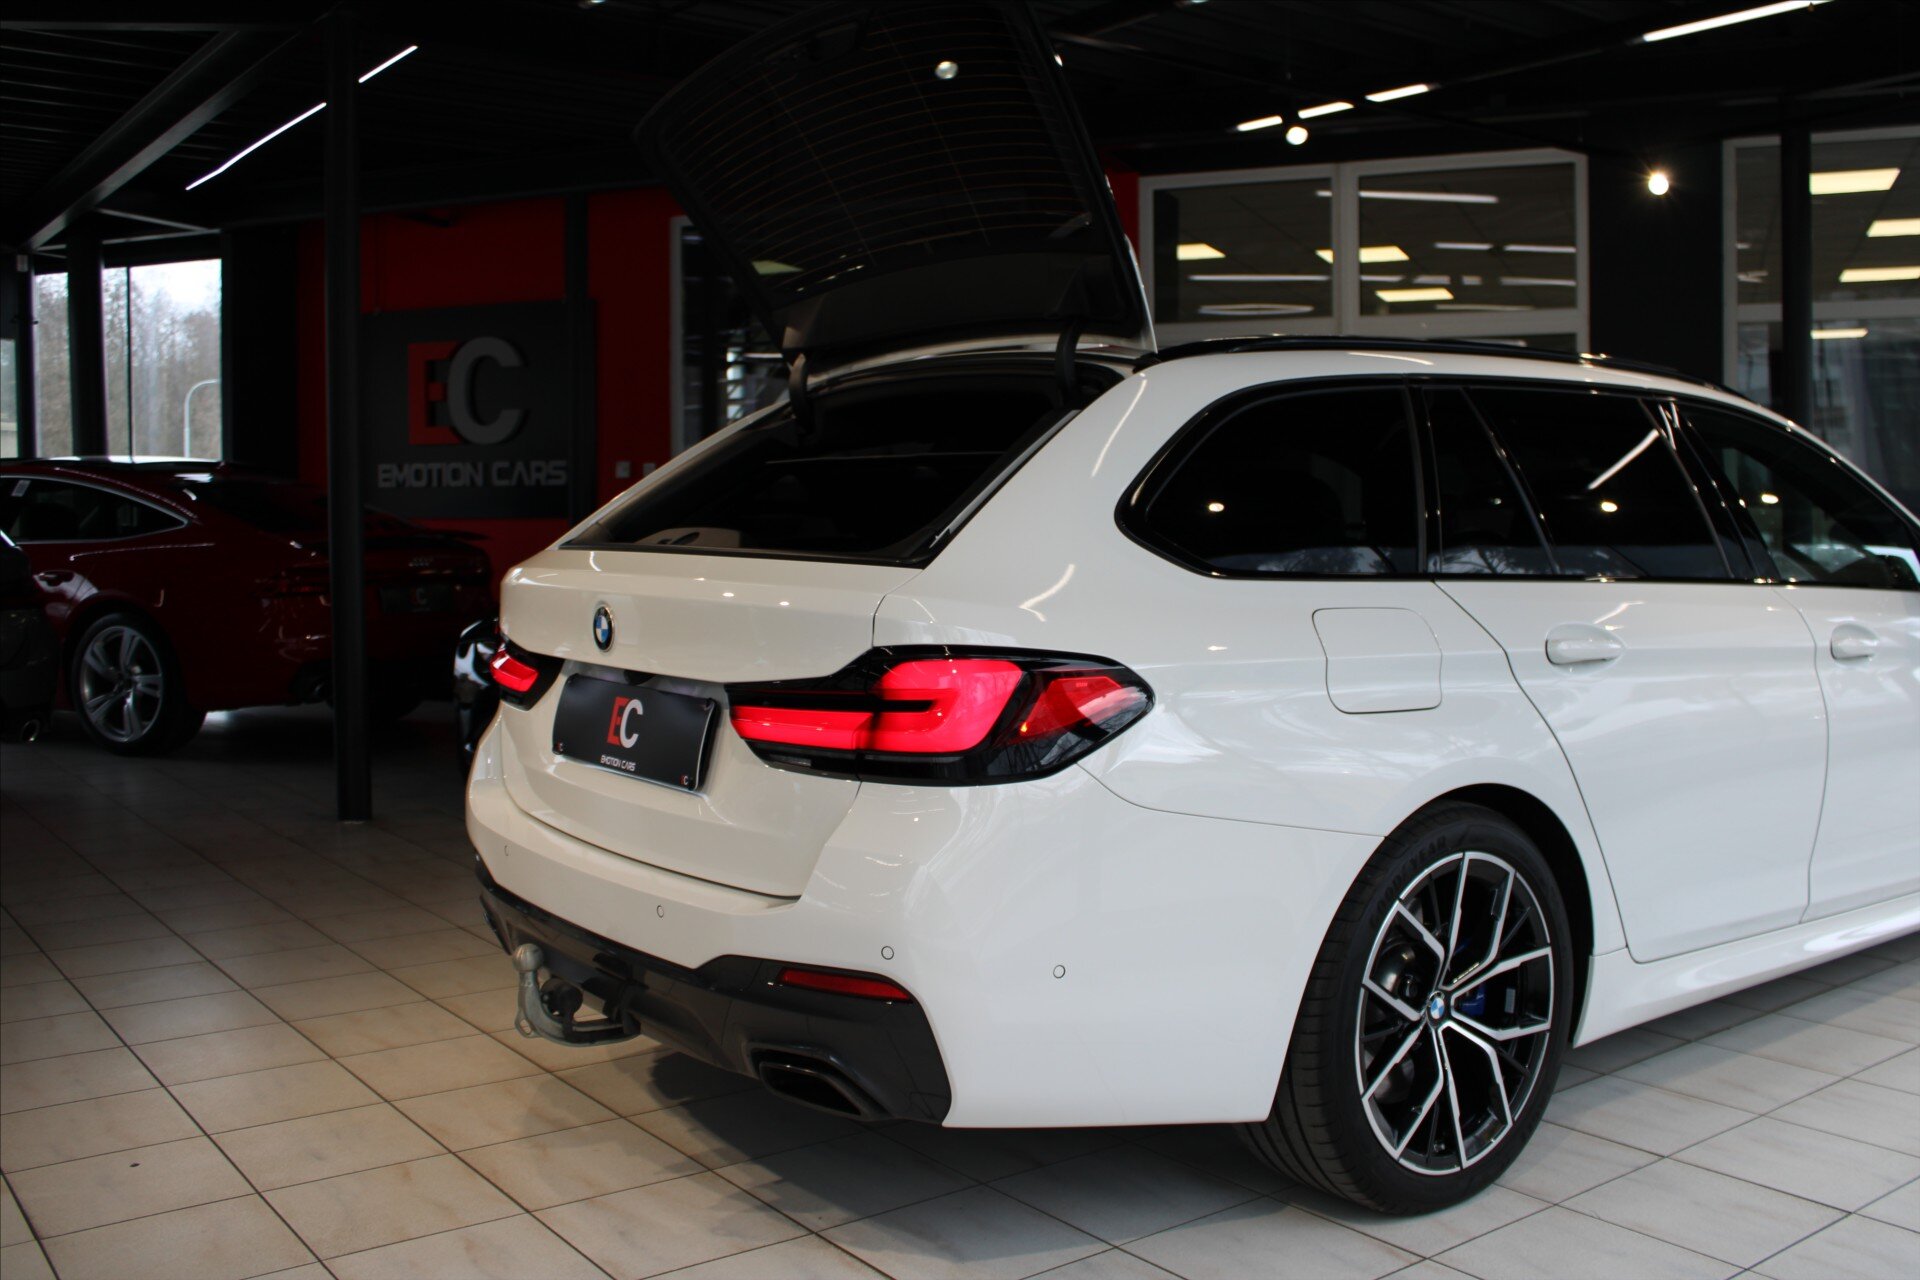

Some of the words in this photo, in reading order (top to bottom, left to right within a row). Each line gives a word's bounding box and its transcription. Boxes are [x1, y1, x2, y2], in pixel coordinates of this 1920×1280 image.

[407, 336, 524, 446] EC
[377, 462, 484, 489] EMOTION
[491, 460, 569, 487] CARS
[607, 696, 644, 749] EC
